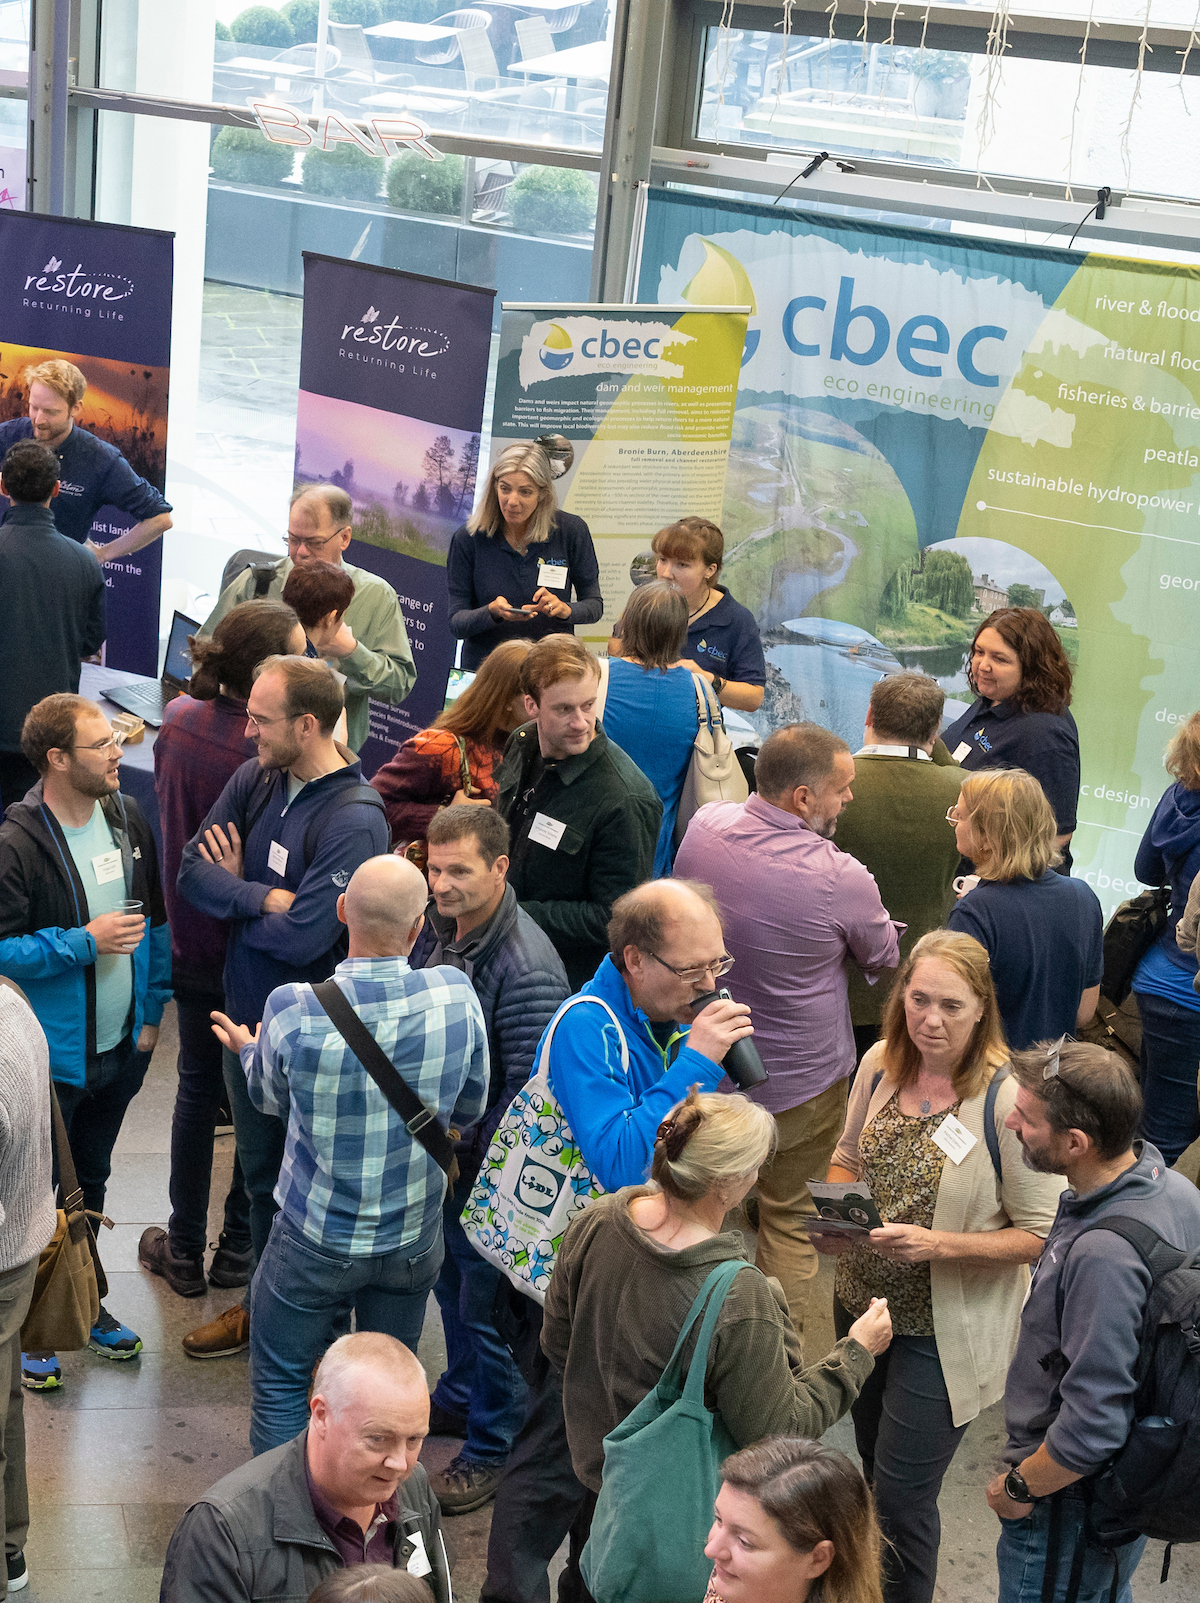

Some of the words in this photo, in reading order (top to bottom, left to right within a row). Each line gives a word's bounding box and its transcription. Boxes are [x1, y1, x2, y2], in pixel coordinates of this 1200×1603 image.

[253, 103, 434, 158] BAR
[24, 264, 124, 300] restore
[22, 298, 91, 317] Returning
[99, 310, 124, 321] Life
[1096, 294, 1134, 314] river
[1139, 299, 1153, 316] &
[341, 315, 438, 356] restore
[782, 275, 1008, 388] cbec
[581, 329, 660, 359] cbec
[339, 348, 405, 373] Returning
[413, 365, 437, 379] Life
[612, 361, 658, 371] engineering
[1104, 347, 1165, 366] natural
[1171, 351, 1200, 371] floo
[596, 382, 619, 392] dam
[621, 382, 641, 392] and
[643, 383, 665, 393] weir
[667, 384, 733, 395] management
[823, 375, 859, 393] eco
[866, 384, 995, 421] engineering
[1058, 384, 1128, 408] fisheries
[1132, 396, 1145, 411] &
[1150, 398, 1200, 420] barrie
[1144, 448, 1200, 468] peatla
[988, 468, 1083, 495] sustainable
[1088, 482, 1193, 515] hydropower
[126, 564, 142, 575] the
[423, 602, 433, 613] of
[416, 620, 426, 631] to
[415, 639, 424, 650] to
[1094, 784, 1151, 809] design
[522, 1174, 554, 1198] LIDL
